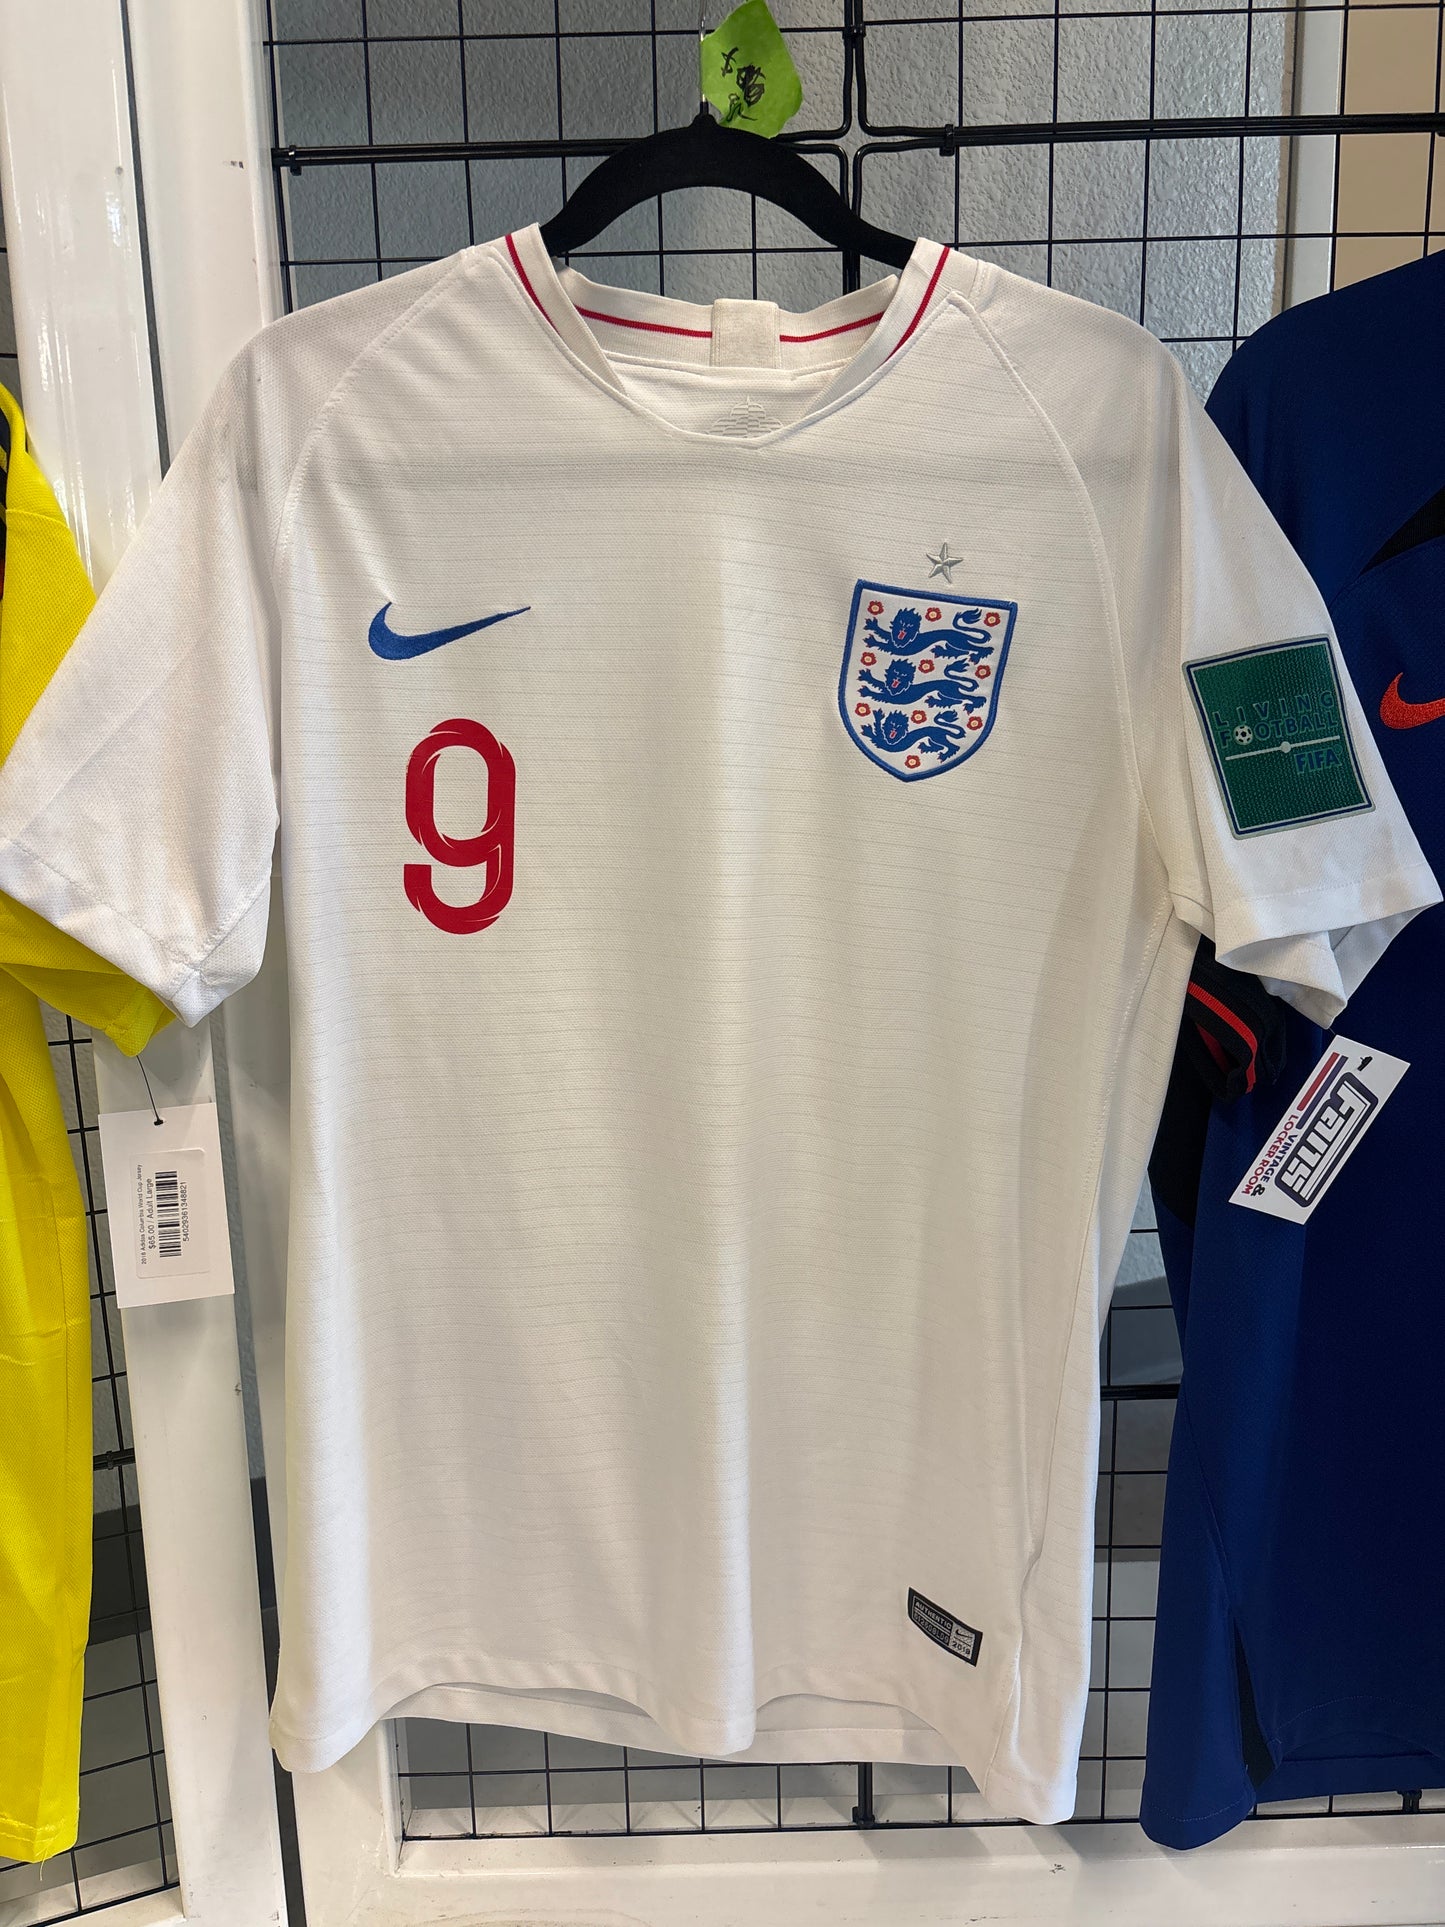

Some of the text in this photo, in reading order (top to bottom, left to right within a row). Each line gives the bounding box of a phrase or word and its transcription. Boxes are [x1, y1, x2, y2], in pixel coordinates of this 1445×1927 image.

[1212, 690, 1335, 729] LIVING
[1219, 711, 1338, 748] FOOTBALL
[1294, 748, 1342, 774] FIFA
[404, 718, 516, 935] 9
[1241, 1114, 1299, 1195] LOCKER ROOM
[1250, 1134, 1298, 1197] VINTAGE &
[145, 1178, 154, 1199] Large
[145, 1200, 154, 1219] Adult
[180, 1181, 190, 1242] 54029361348821
[147, 1224, 156, 1250] $65.00
[915, 1601, 952, 1630] AUTHENTIC
[951, 1640, 971, 1655] 2018
